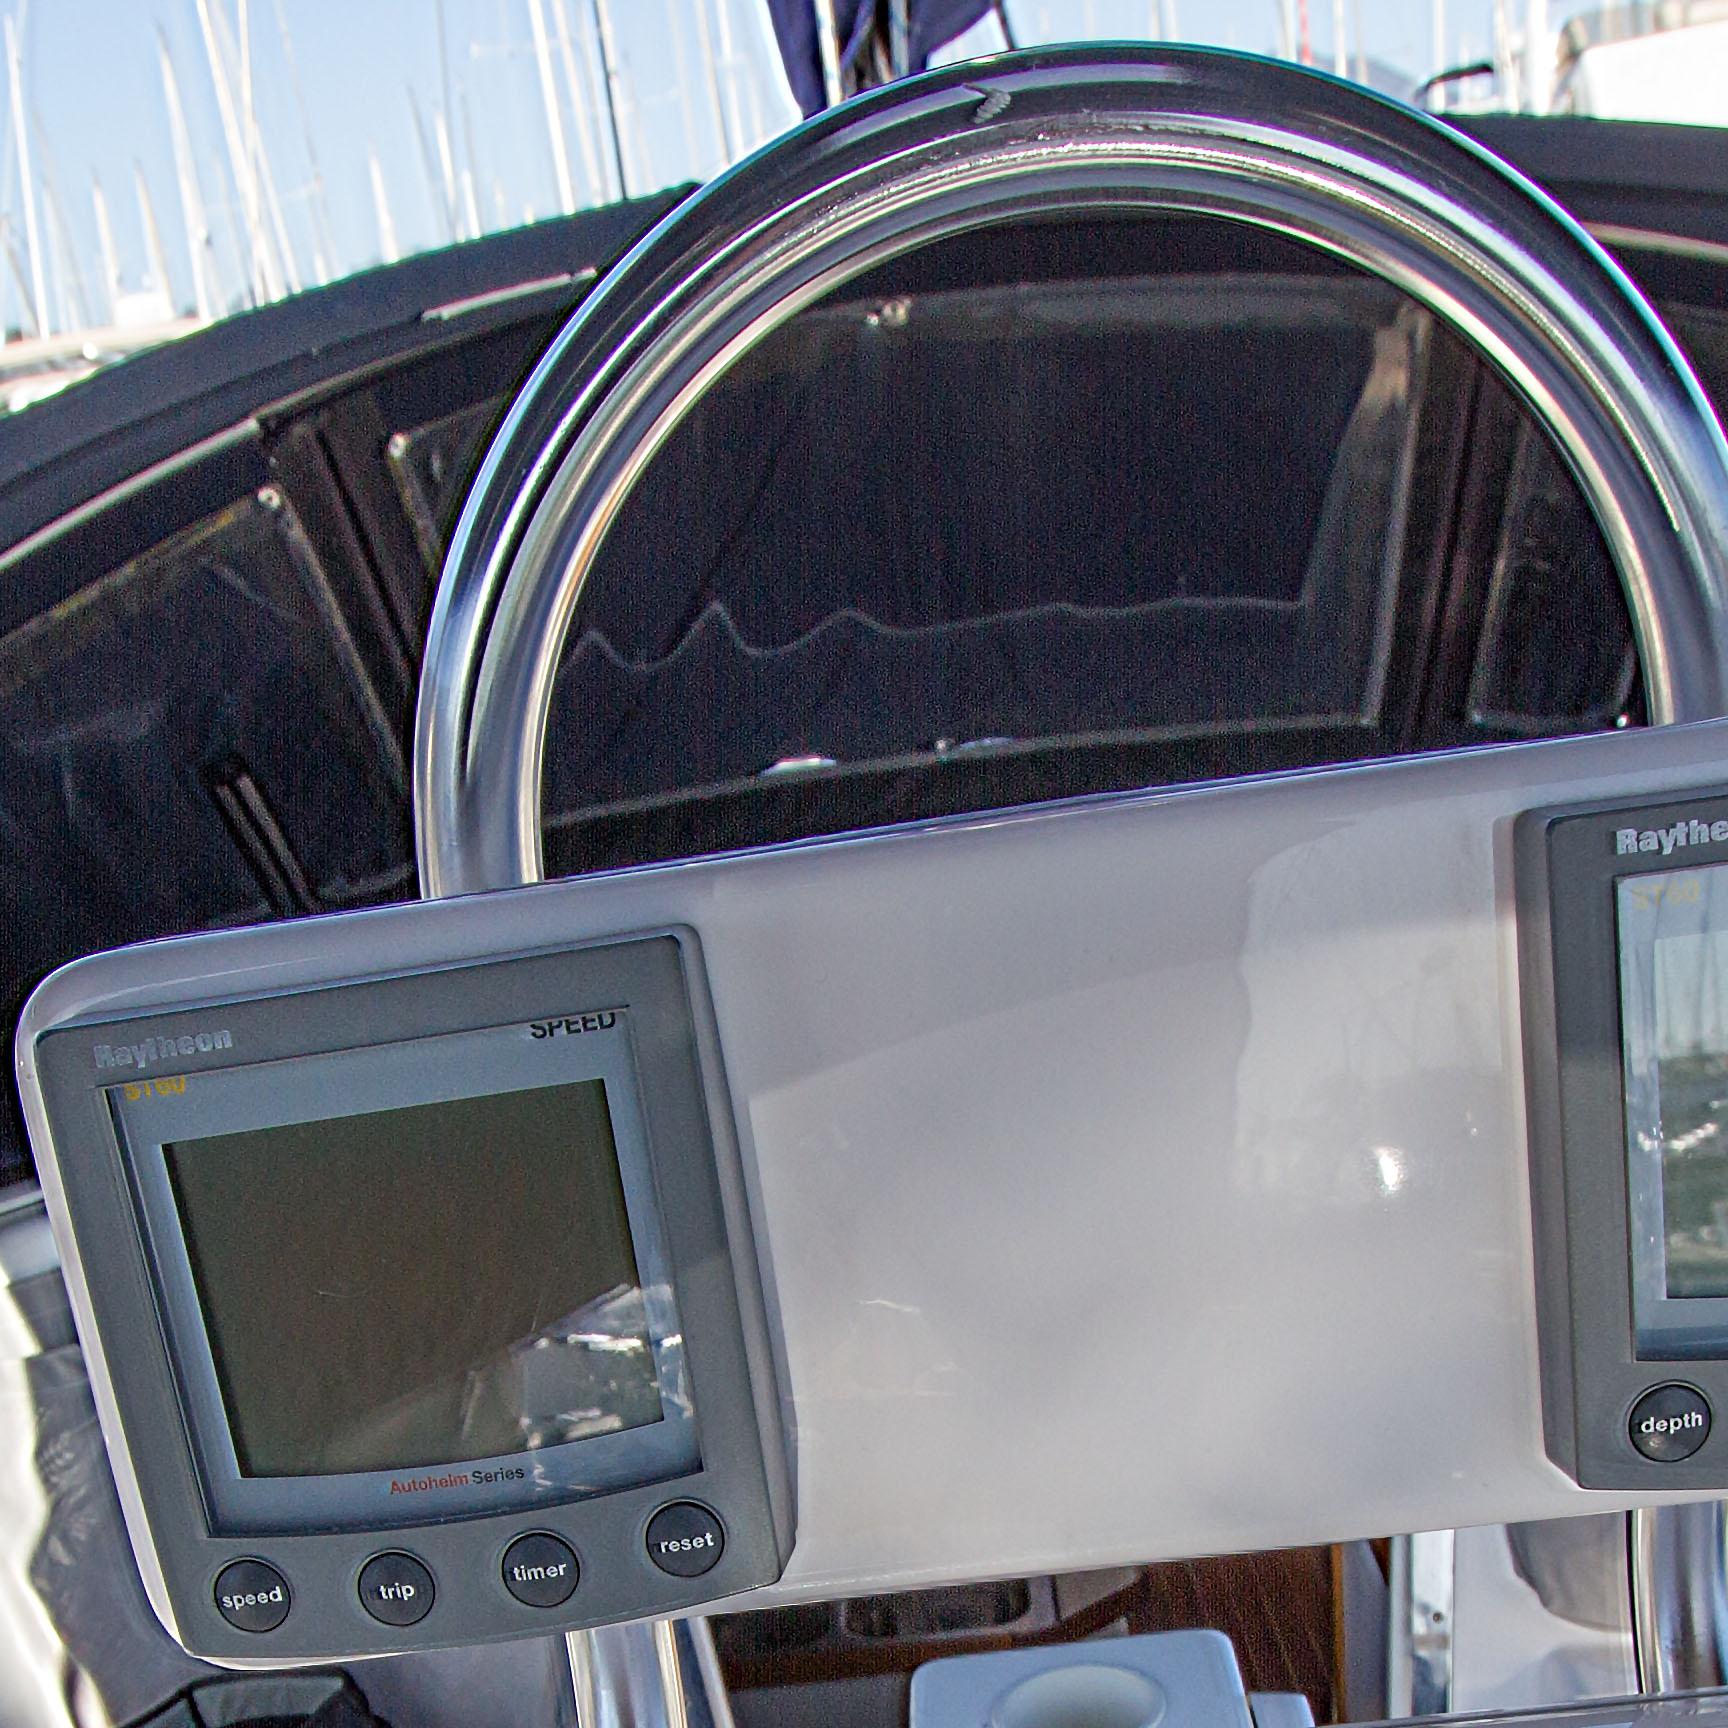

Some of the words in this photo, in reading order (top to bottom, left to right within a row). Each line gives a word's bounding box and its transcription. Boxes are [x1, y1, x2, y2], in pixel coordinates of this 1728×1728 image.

[530, 1011, 617, 1039] SPEED
[93, 1029, 234, 1069] Raytheon
[1640, 1410, 1704, 1436] depth
[390, 1472, 470, 1496] Autohelm
[471, 1466, 525, 1485] Series
[659, 1531, 715, 1555] reset
[512, 1559, 568, 1582] timer
[221, 1585, 283, 1611] speed
[378, 1581, 415, 1603] trip
